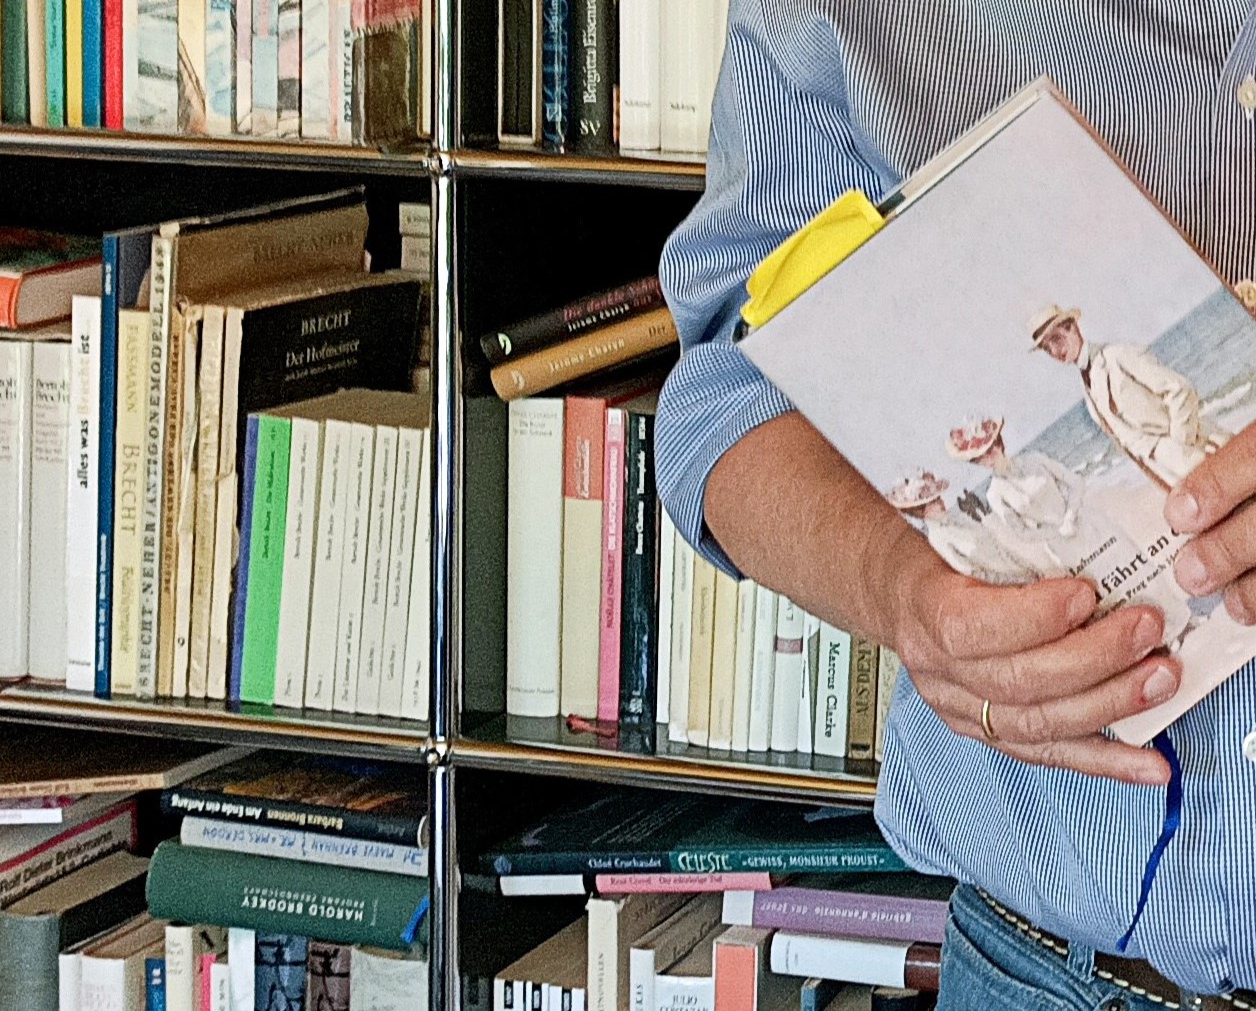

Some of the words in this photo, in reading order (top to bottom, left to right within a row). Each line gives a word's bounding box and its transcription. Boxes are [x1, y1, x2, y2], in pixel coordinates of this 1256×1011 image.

[301, 310, 352, 336] BRECHT
[78, 333, 91, 356] ist
[285, 349, 305, 368] Der
[79, 419, 90, 450] was
[78, 453, 90, 490] alles
[1100, 552, 1148, 596] fährt
[826, 641, 842, 691] Marcus
[855, 687, 871, 717] AUS
[824, 693, 840, 739] Clarke
[171, 793, 205, 813] Anfang
[205, 800, 221, 814] ein
[221, 802, 244, 818] Ende
[244, 806, 263, 819] Am
[267, 809, 306, 826] Bronnen
[306, 813, 344, 830] Barbara
[311, 839, 359, 856] BRENNAN
[240, 895, 304, 915] BRODKEY
[321, 895, 365, 908] PROFANE
[308, 903, 364, 922] HAROLD
[672, 994, 698, 1007] JULIO
